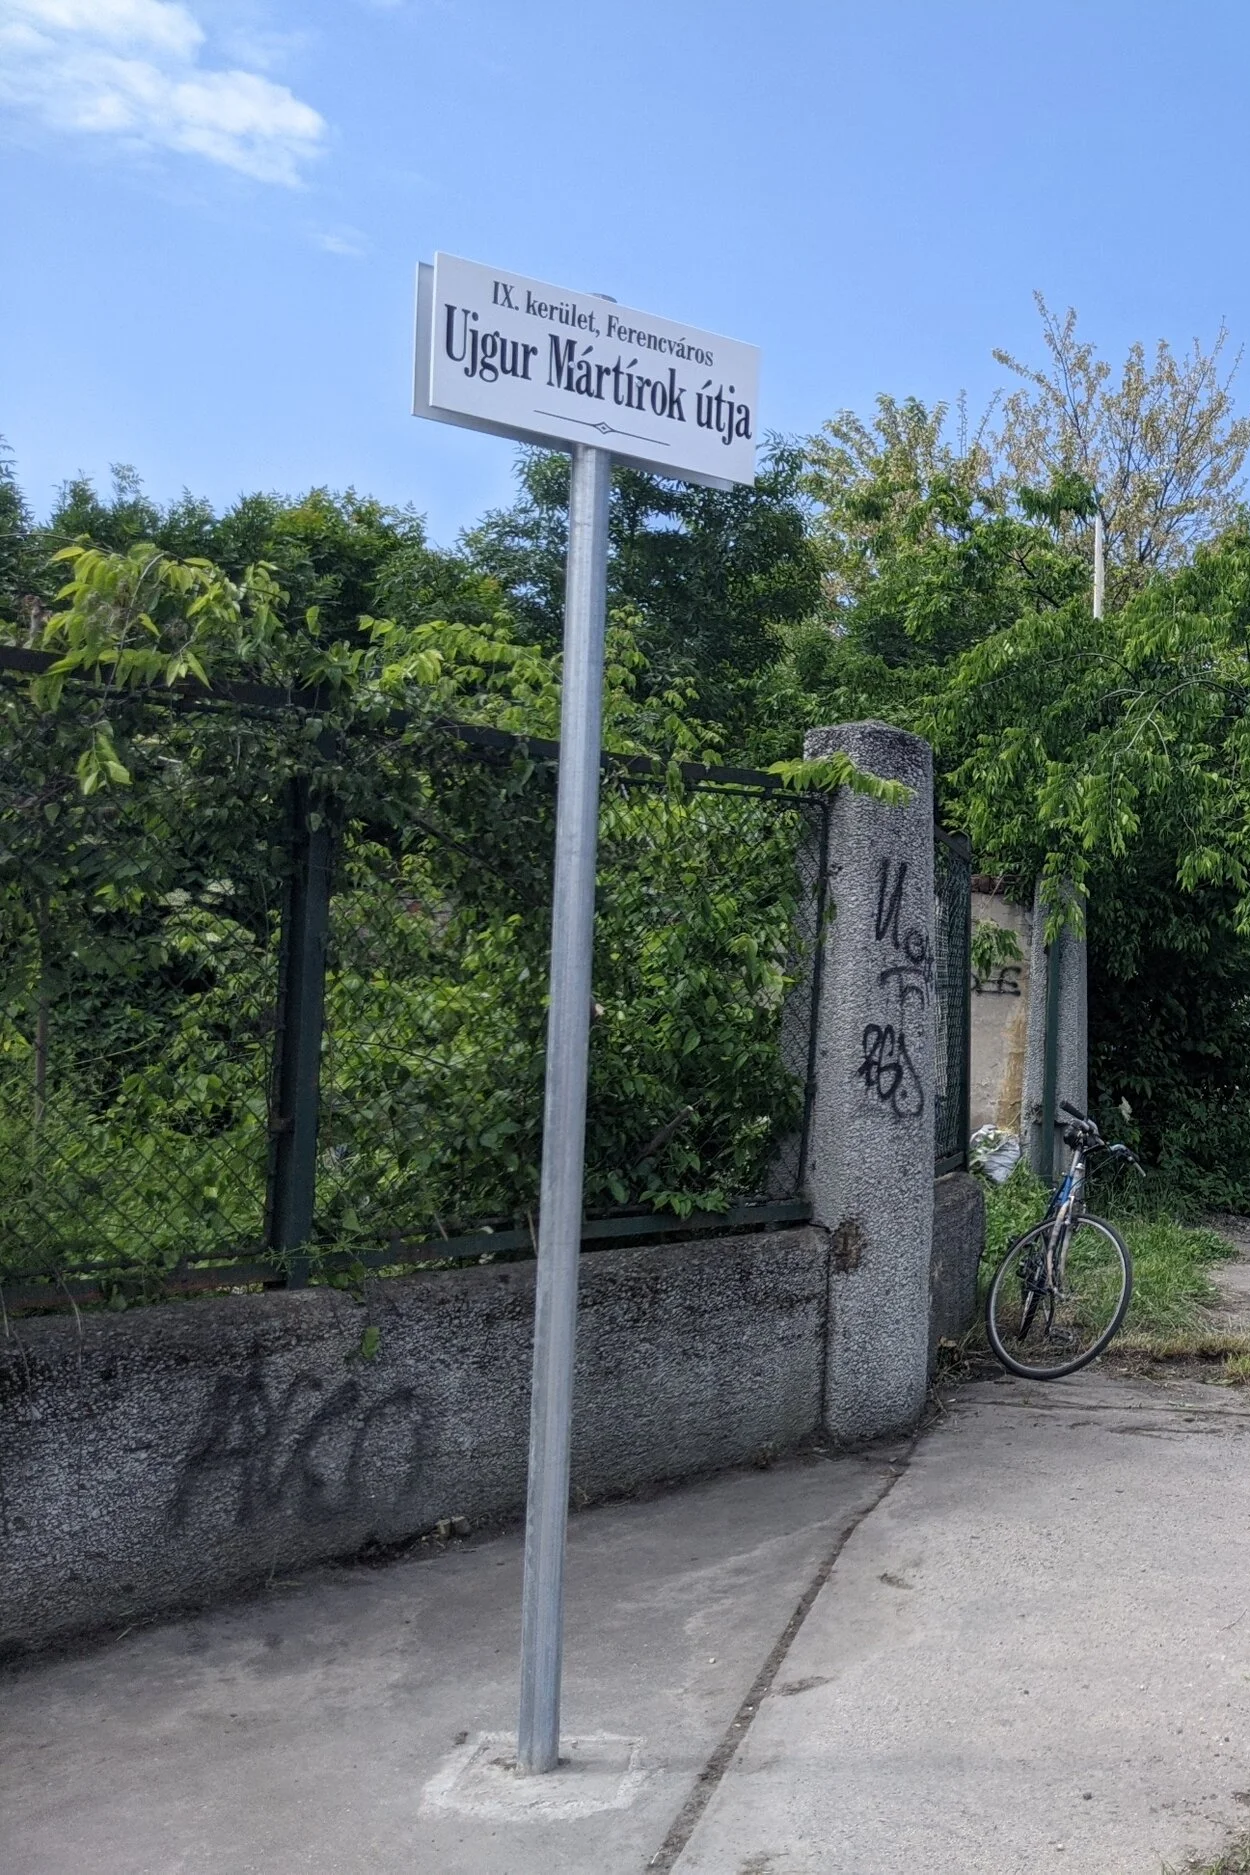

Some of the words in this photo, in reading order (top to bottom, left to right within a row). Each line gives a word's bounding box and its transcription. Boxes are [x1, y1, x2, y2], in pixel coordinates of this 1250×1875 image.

[444, 303, 539, 383] Ujgur
[547, 333, 687, 423] Mártírok
[696, 379, 753, 446] útja
[491, 280, 520, 311] IX.
[525, 290, 601, 338] kerület,
[606, 314, 714, 367] Ferencváros
